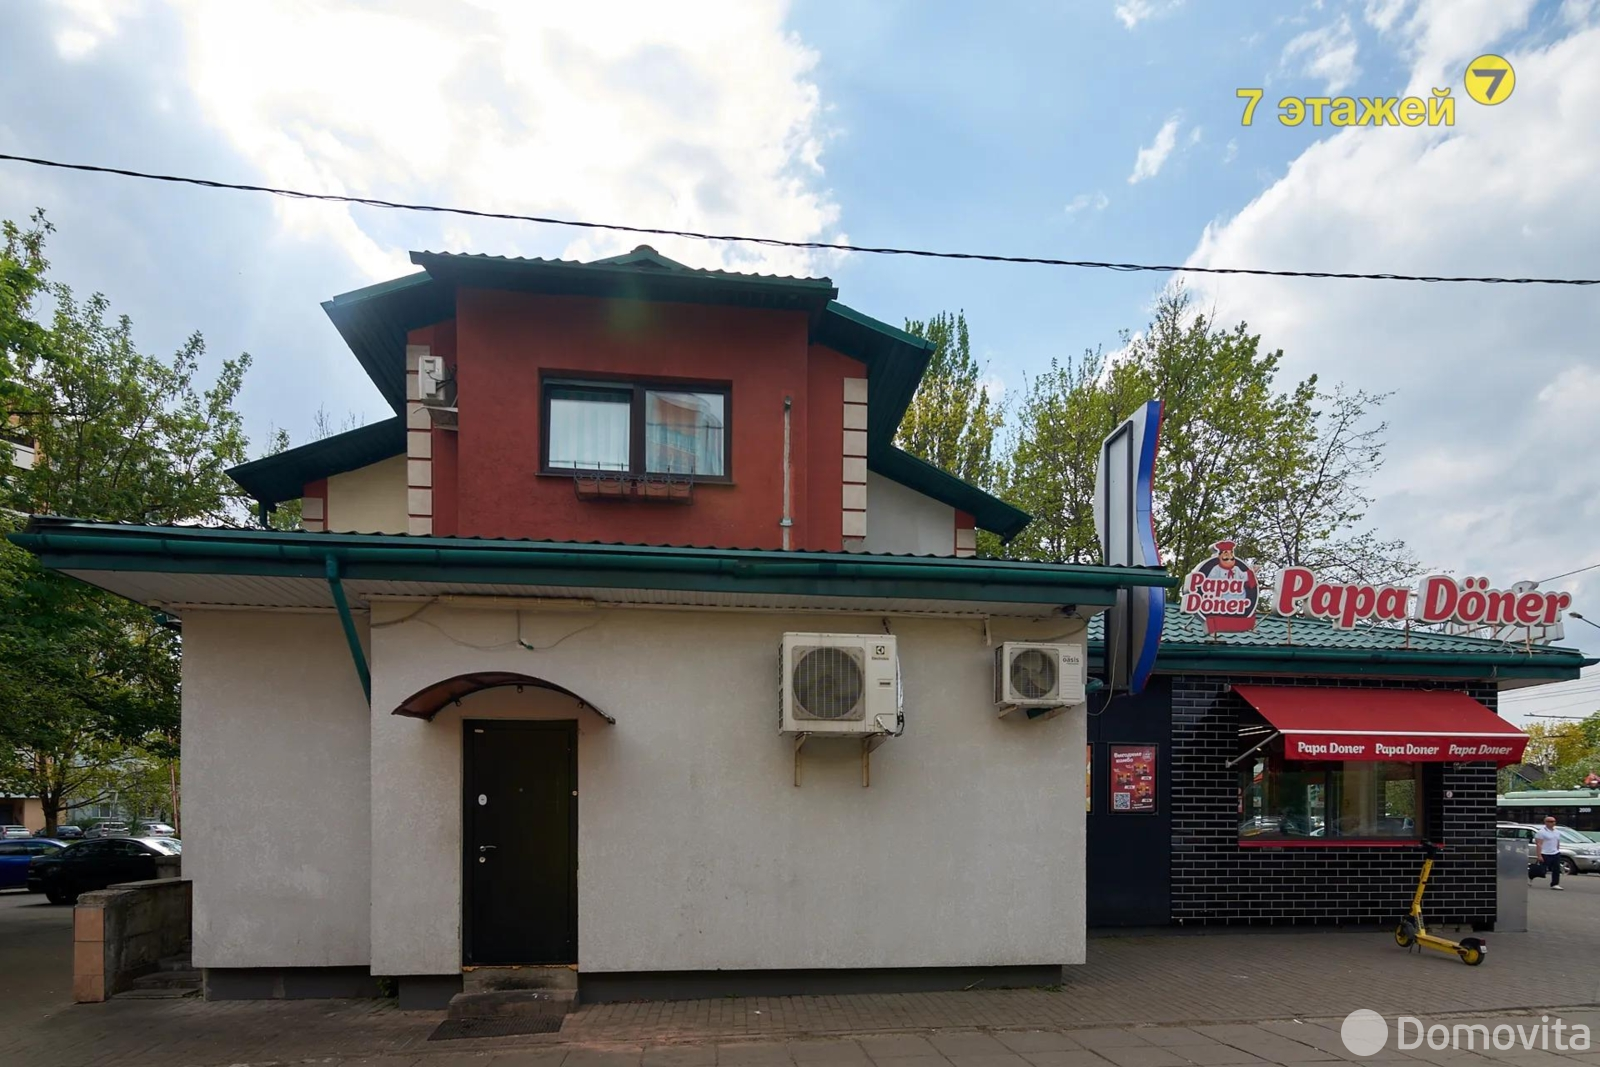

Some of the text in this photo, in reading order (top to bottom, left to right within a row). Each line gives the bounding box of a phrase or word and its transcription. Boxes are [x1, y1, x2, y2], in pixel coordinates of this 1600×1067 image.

[1189, 572, 1243, 598] Papa
[1185, 593, 1251, 613] Döner
[1276, 568, 1571, 629] Papa Döner
[1297, 741, 1365, 756] Papa Doner
[1375, 743, 1440, 757] Papa Doner
[1448, 744, 1513, 757] Papa Doner
